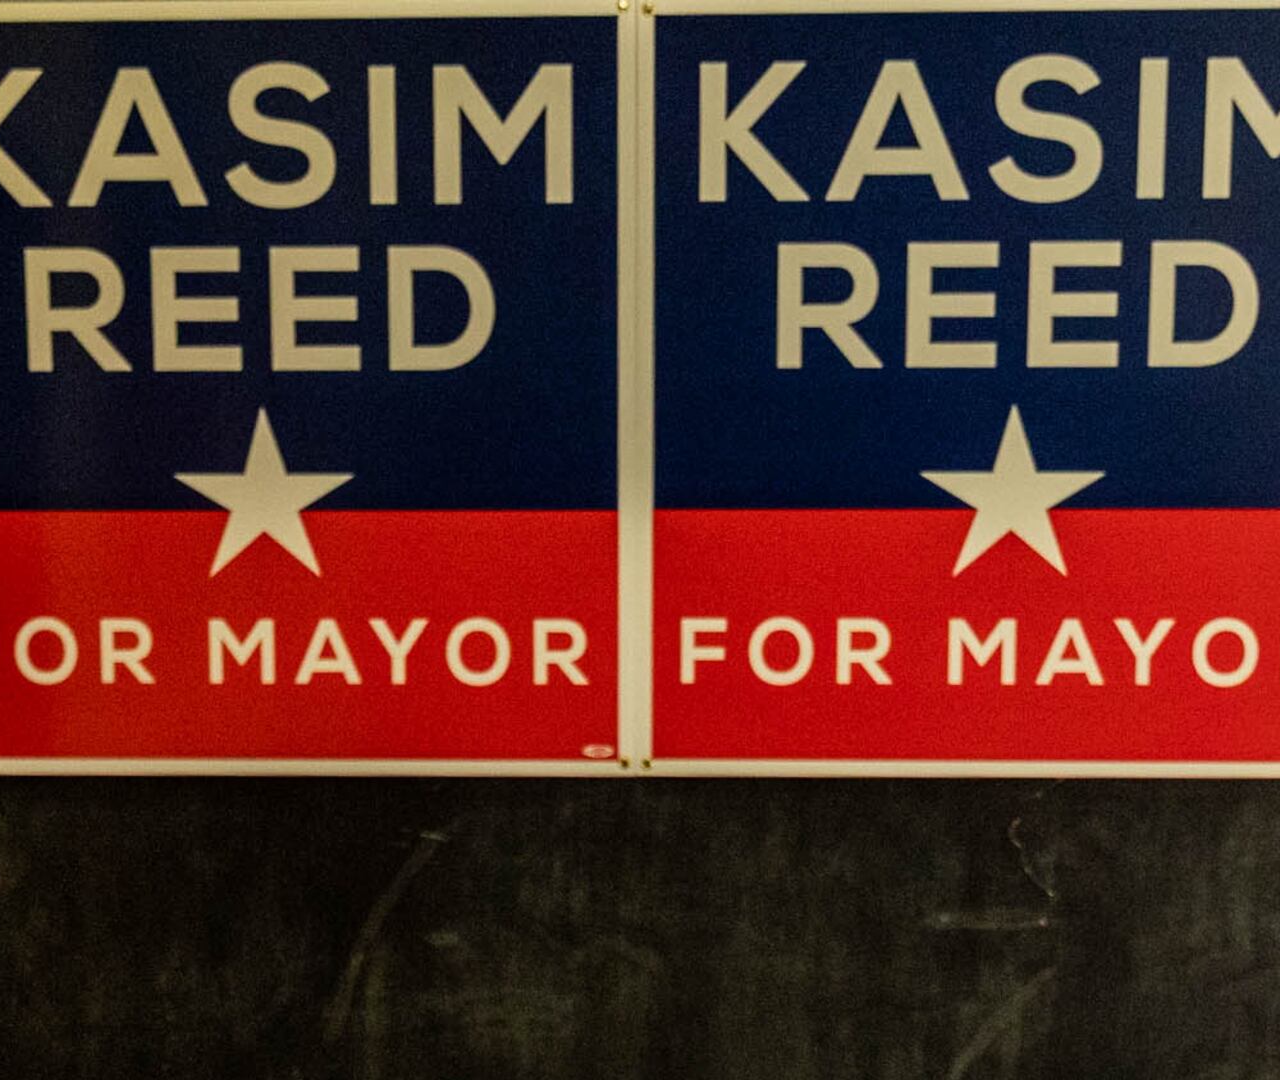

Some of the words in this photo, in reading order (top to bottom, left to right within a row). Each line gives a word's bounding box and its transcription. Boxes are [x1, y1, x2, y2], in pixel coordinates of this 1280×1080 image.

[23, 246, 497, 373] REED
[776, 240, 1260, 370] REED
[208, 617, 589, 687] MAYOR
[679, 617, 893, 685] FOR
